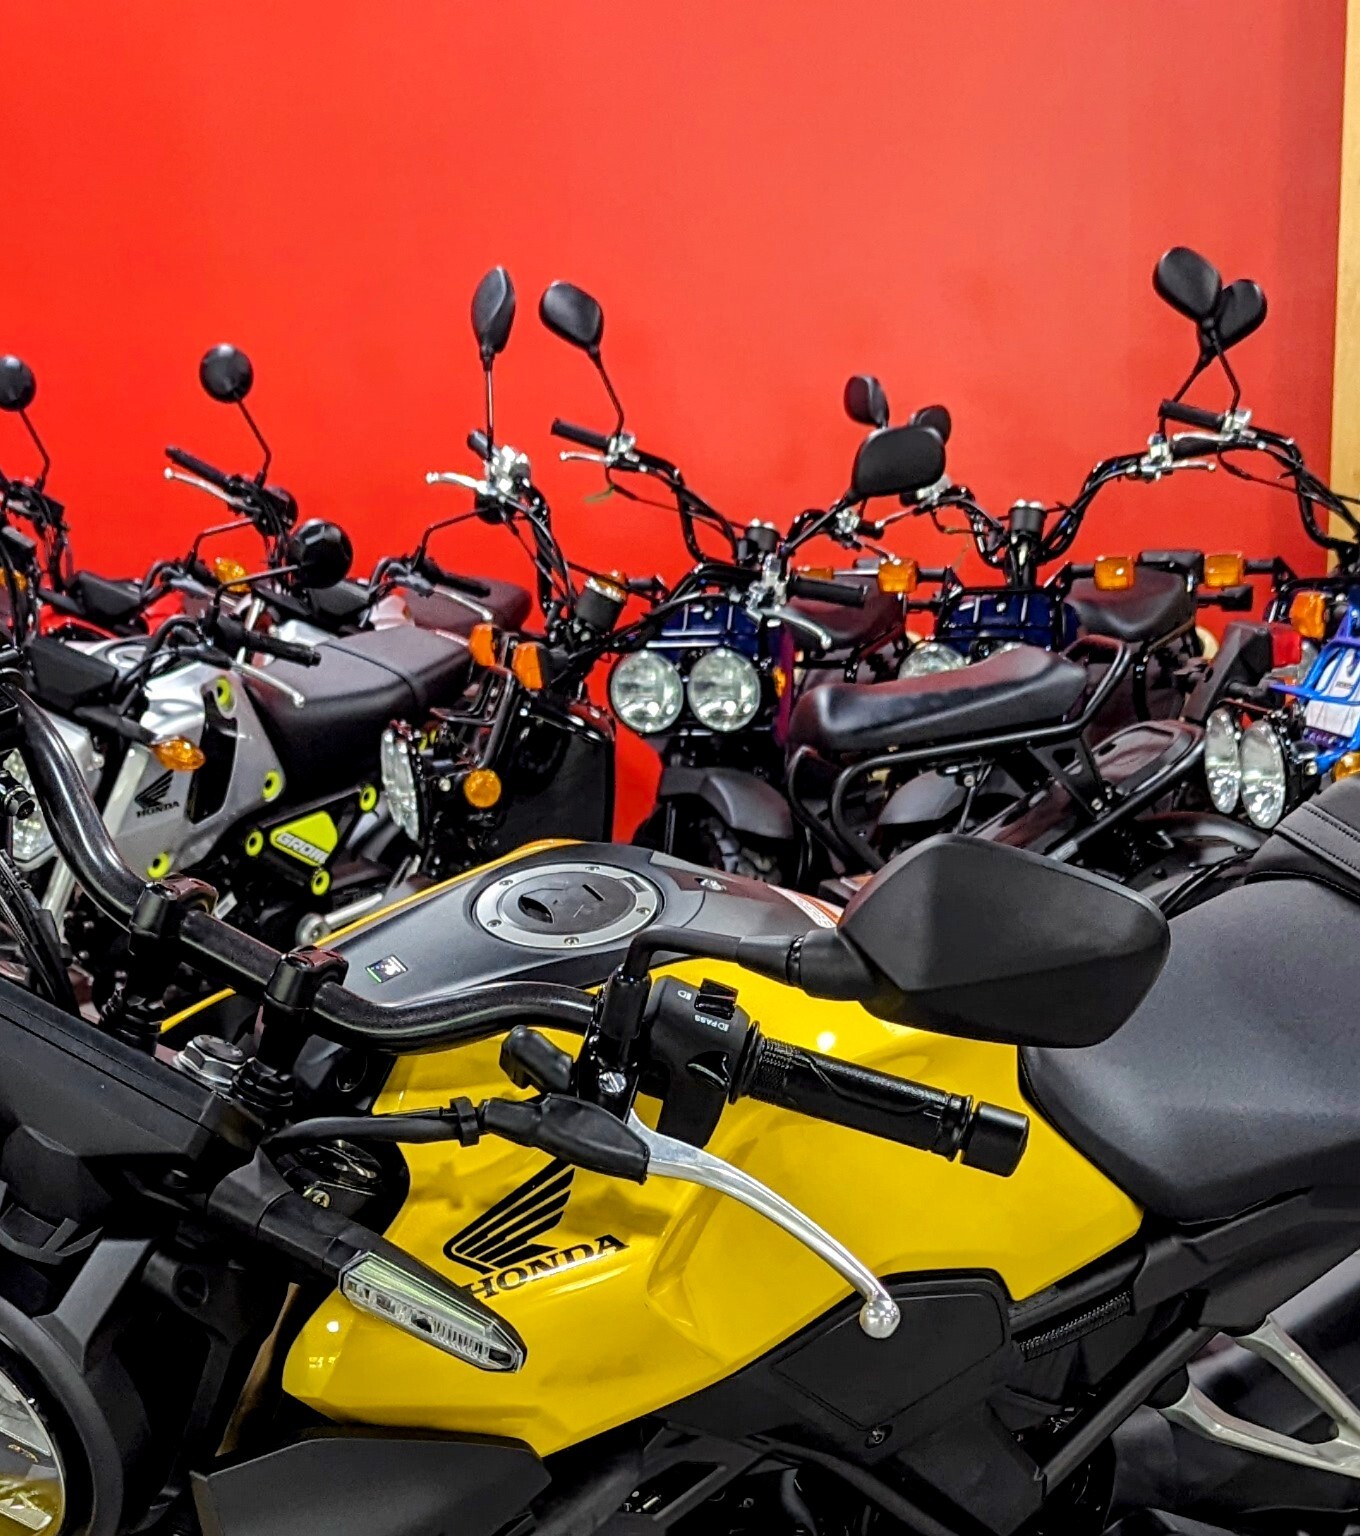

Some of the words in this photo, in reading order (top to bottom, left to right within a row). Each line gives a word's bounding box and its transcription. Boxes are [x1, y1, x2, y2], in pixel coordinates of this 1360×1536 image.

[136, 801, 180, 818] HONDA
[277, 832, 329, 864] GROM
[694, 1013, 718, 1029] PASS
[462, 1233, 630, 1299] HONDA
